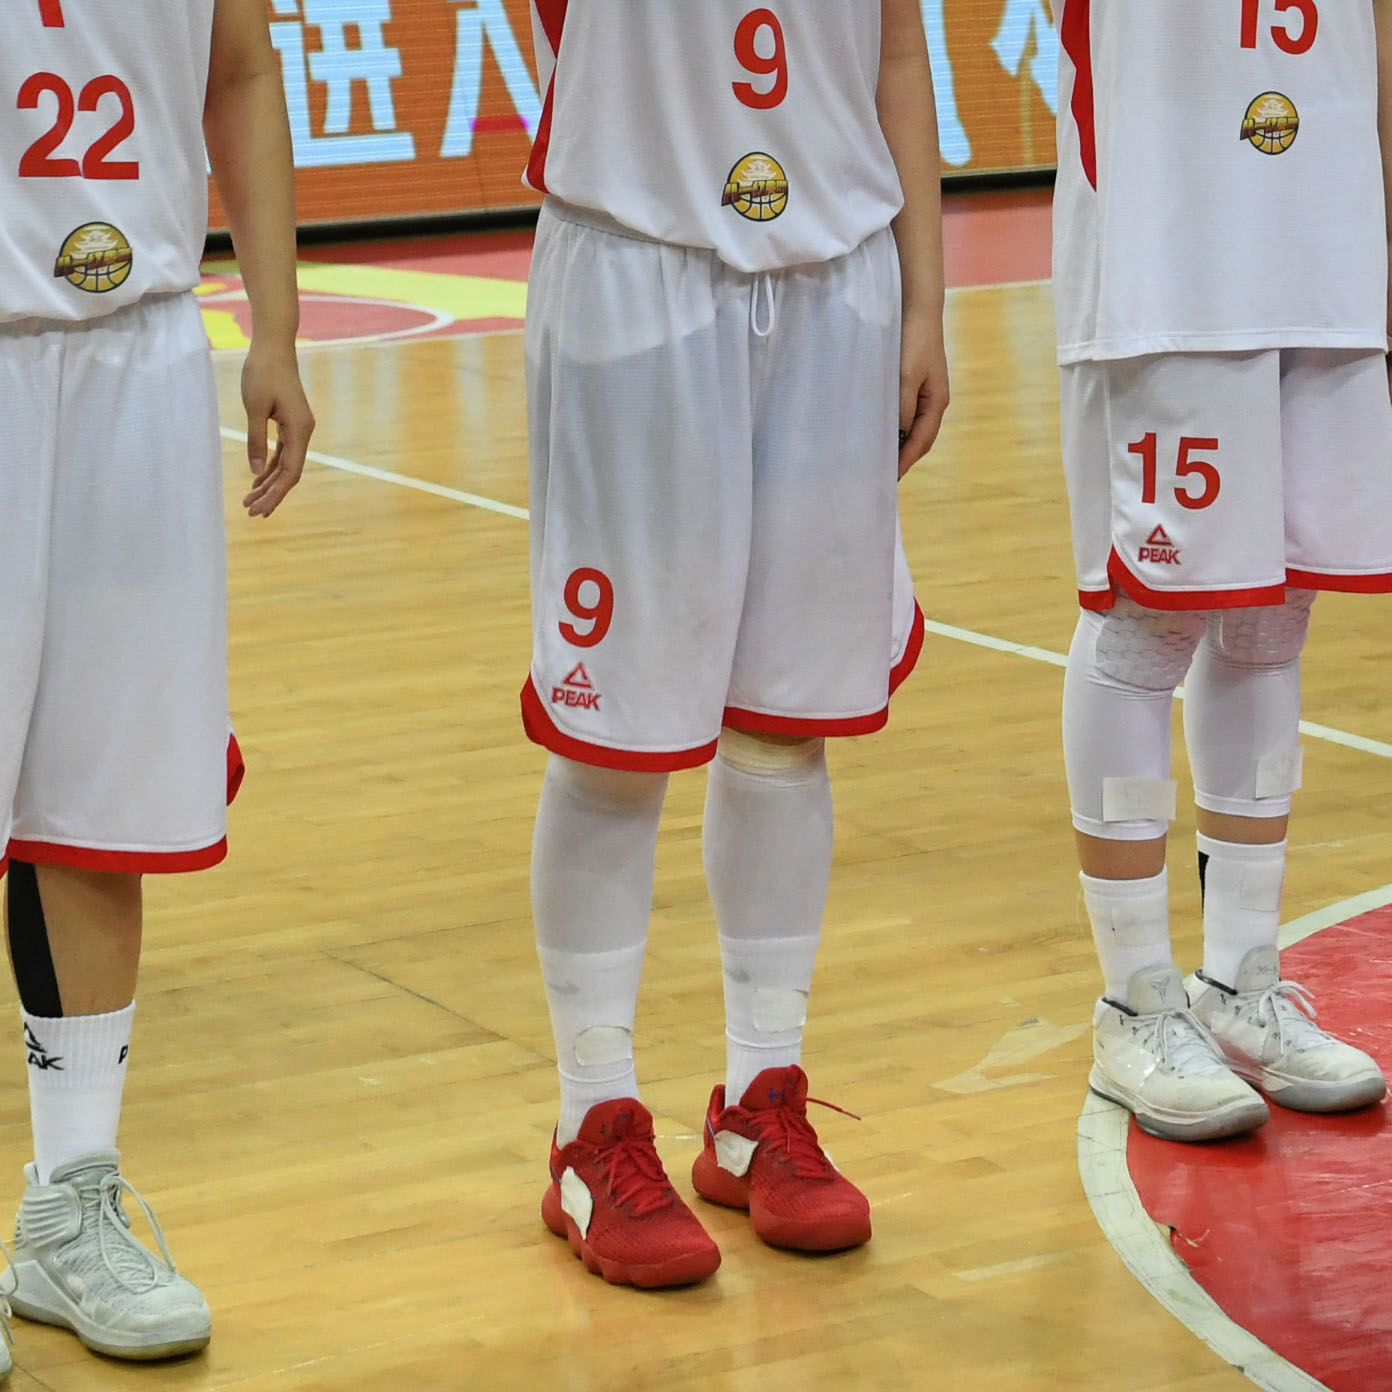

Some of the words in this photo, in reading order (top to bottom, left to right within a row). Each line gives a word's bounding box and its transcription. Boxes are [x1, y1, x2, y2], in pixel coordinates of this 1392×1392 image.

[731, 7, 788, 109] 9
[16, 71, 140, 181] 22
[1127, 431, 1221, 511] 15
[1137, 544, 1181, 565] PEAK
[557, 566, 615, 648] 9
[551, 687, 602, 712] PEAK
